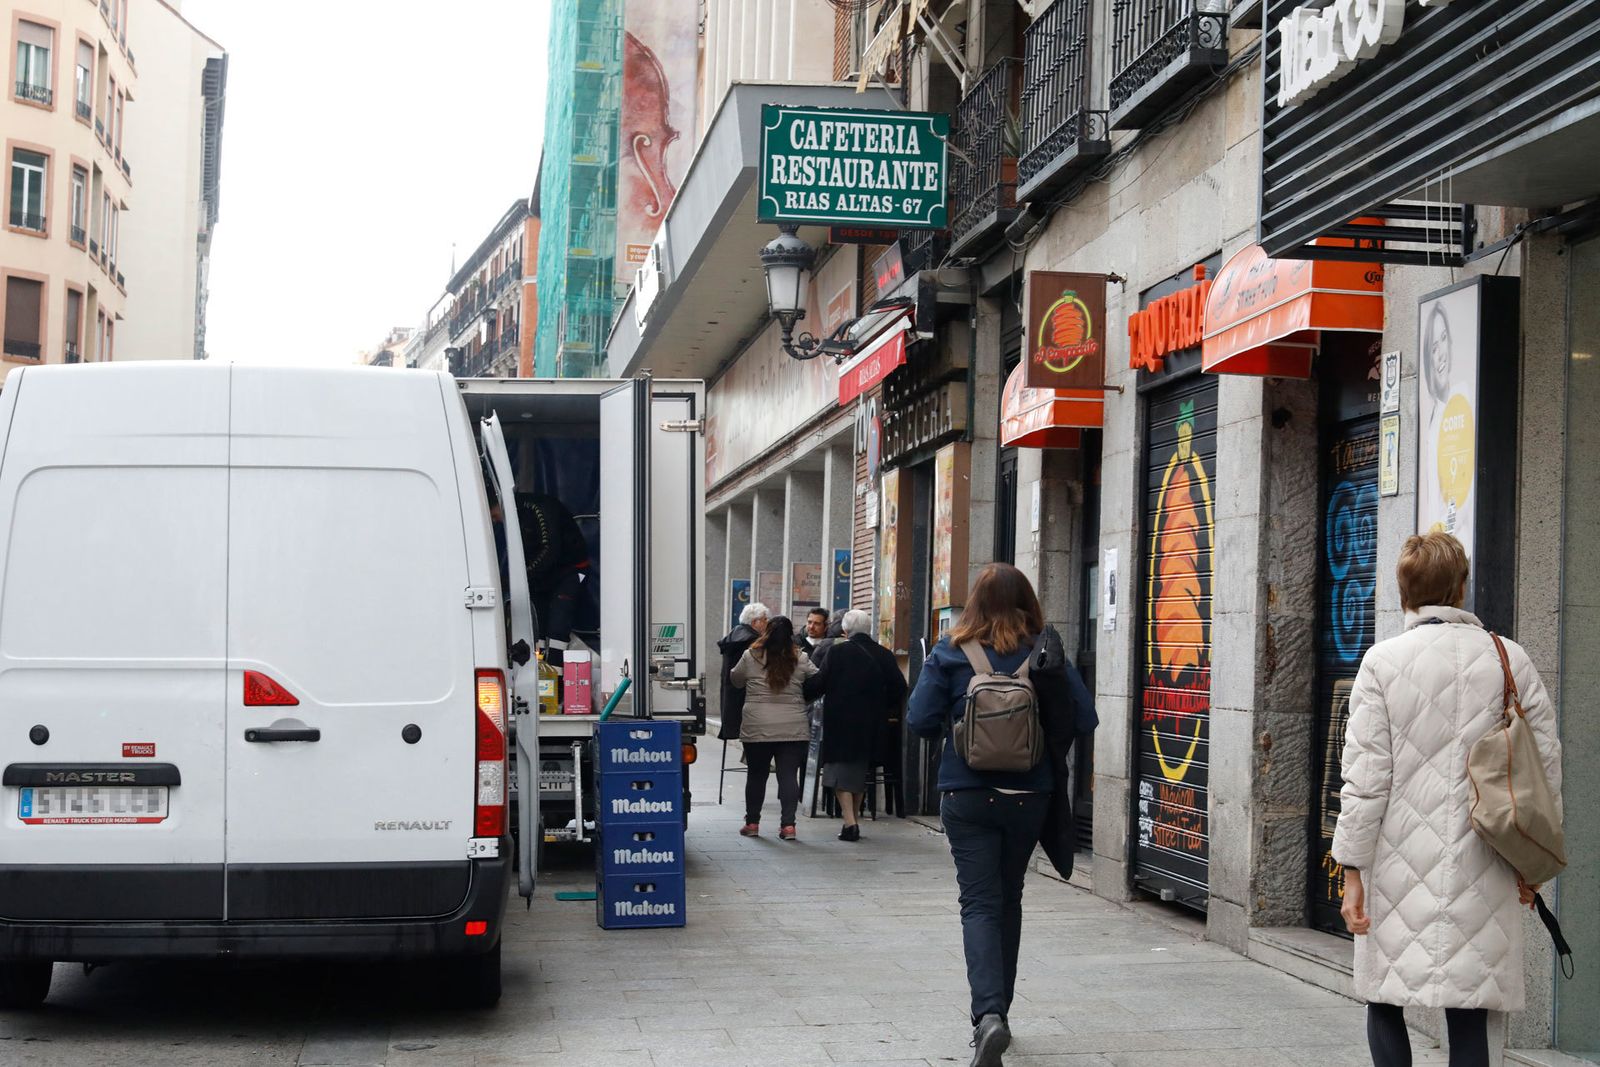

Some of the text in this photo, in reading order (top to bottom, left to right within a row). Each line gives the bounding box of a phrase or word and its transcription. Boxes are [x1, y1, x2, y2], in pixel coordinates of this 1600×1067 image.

[789, 118, 921, 155] CAFETERIA
[770, 154, 939, 191] RESTAURANTE
[784, 190, 831, 211] RIAS
[1442, 414, 1465, 433] CORTE
[610, 747, 673, 764] Mahou
[46, 772, 137, 783] MASTER
[611, 797, 674, 814] Mahou
[374, 820, 453, 831] RENAULT
[613, 848, 675, 865] Mahou
[614, 900, 676, 917] Mahou
